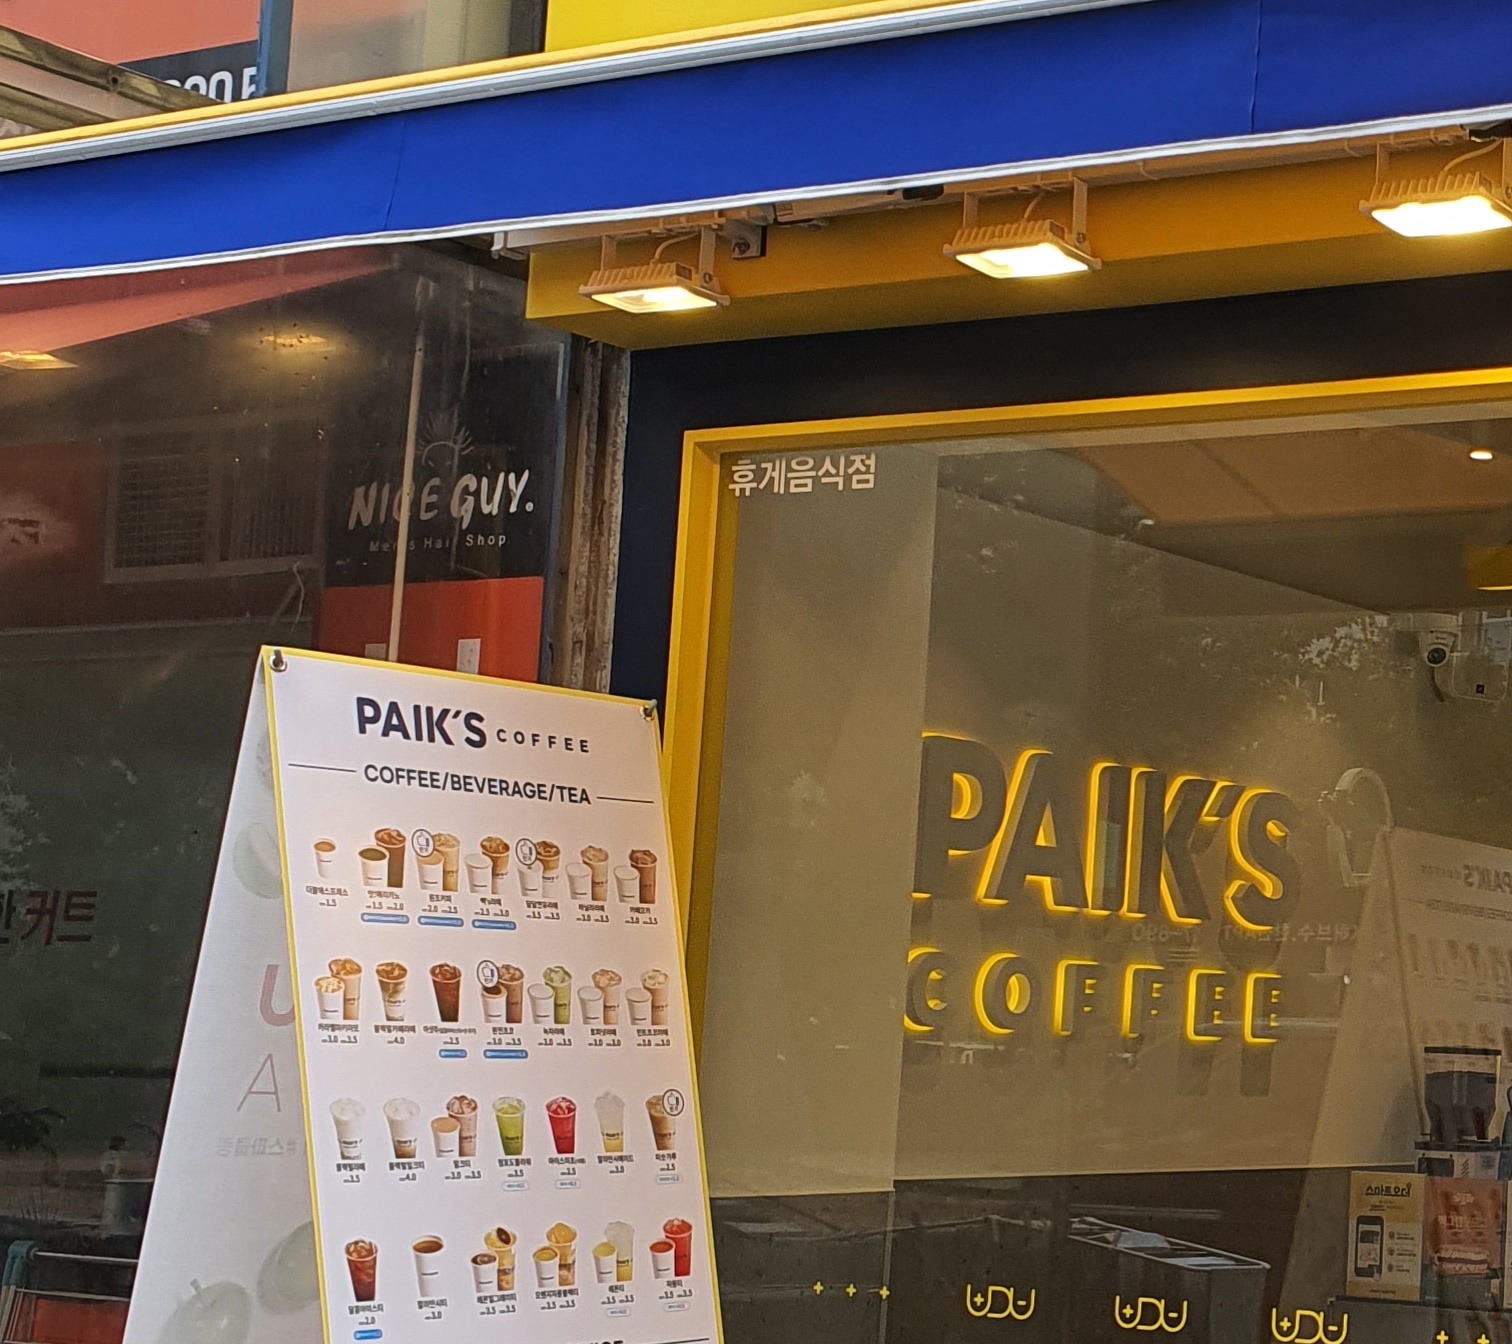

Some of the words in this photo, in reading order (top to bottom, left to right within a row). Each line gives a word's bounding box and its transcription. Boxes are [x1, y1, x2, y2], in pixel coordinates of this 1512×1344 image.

[728, 452, 876, 497] 휴게음식점
[465, 533, 507, 548] Shop
[355, 695, 487, 749] PAIK'S
[496, 728, 591, 754] COFFEE
[363, 763, 591, 806] COFFEE/BEVERAGE/TEA
[911, 731, 1300, 933] PAIK'S
[903, 946, 1283, 1046] COFFEE
